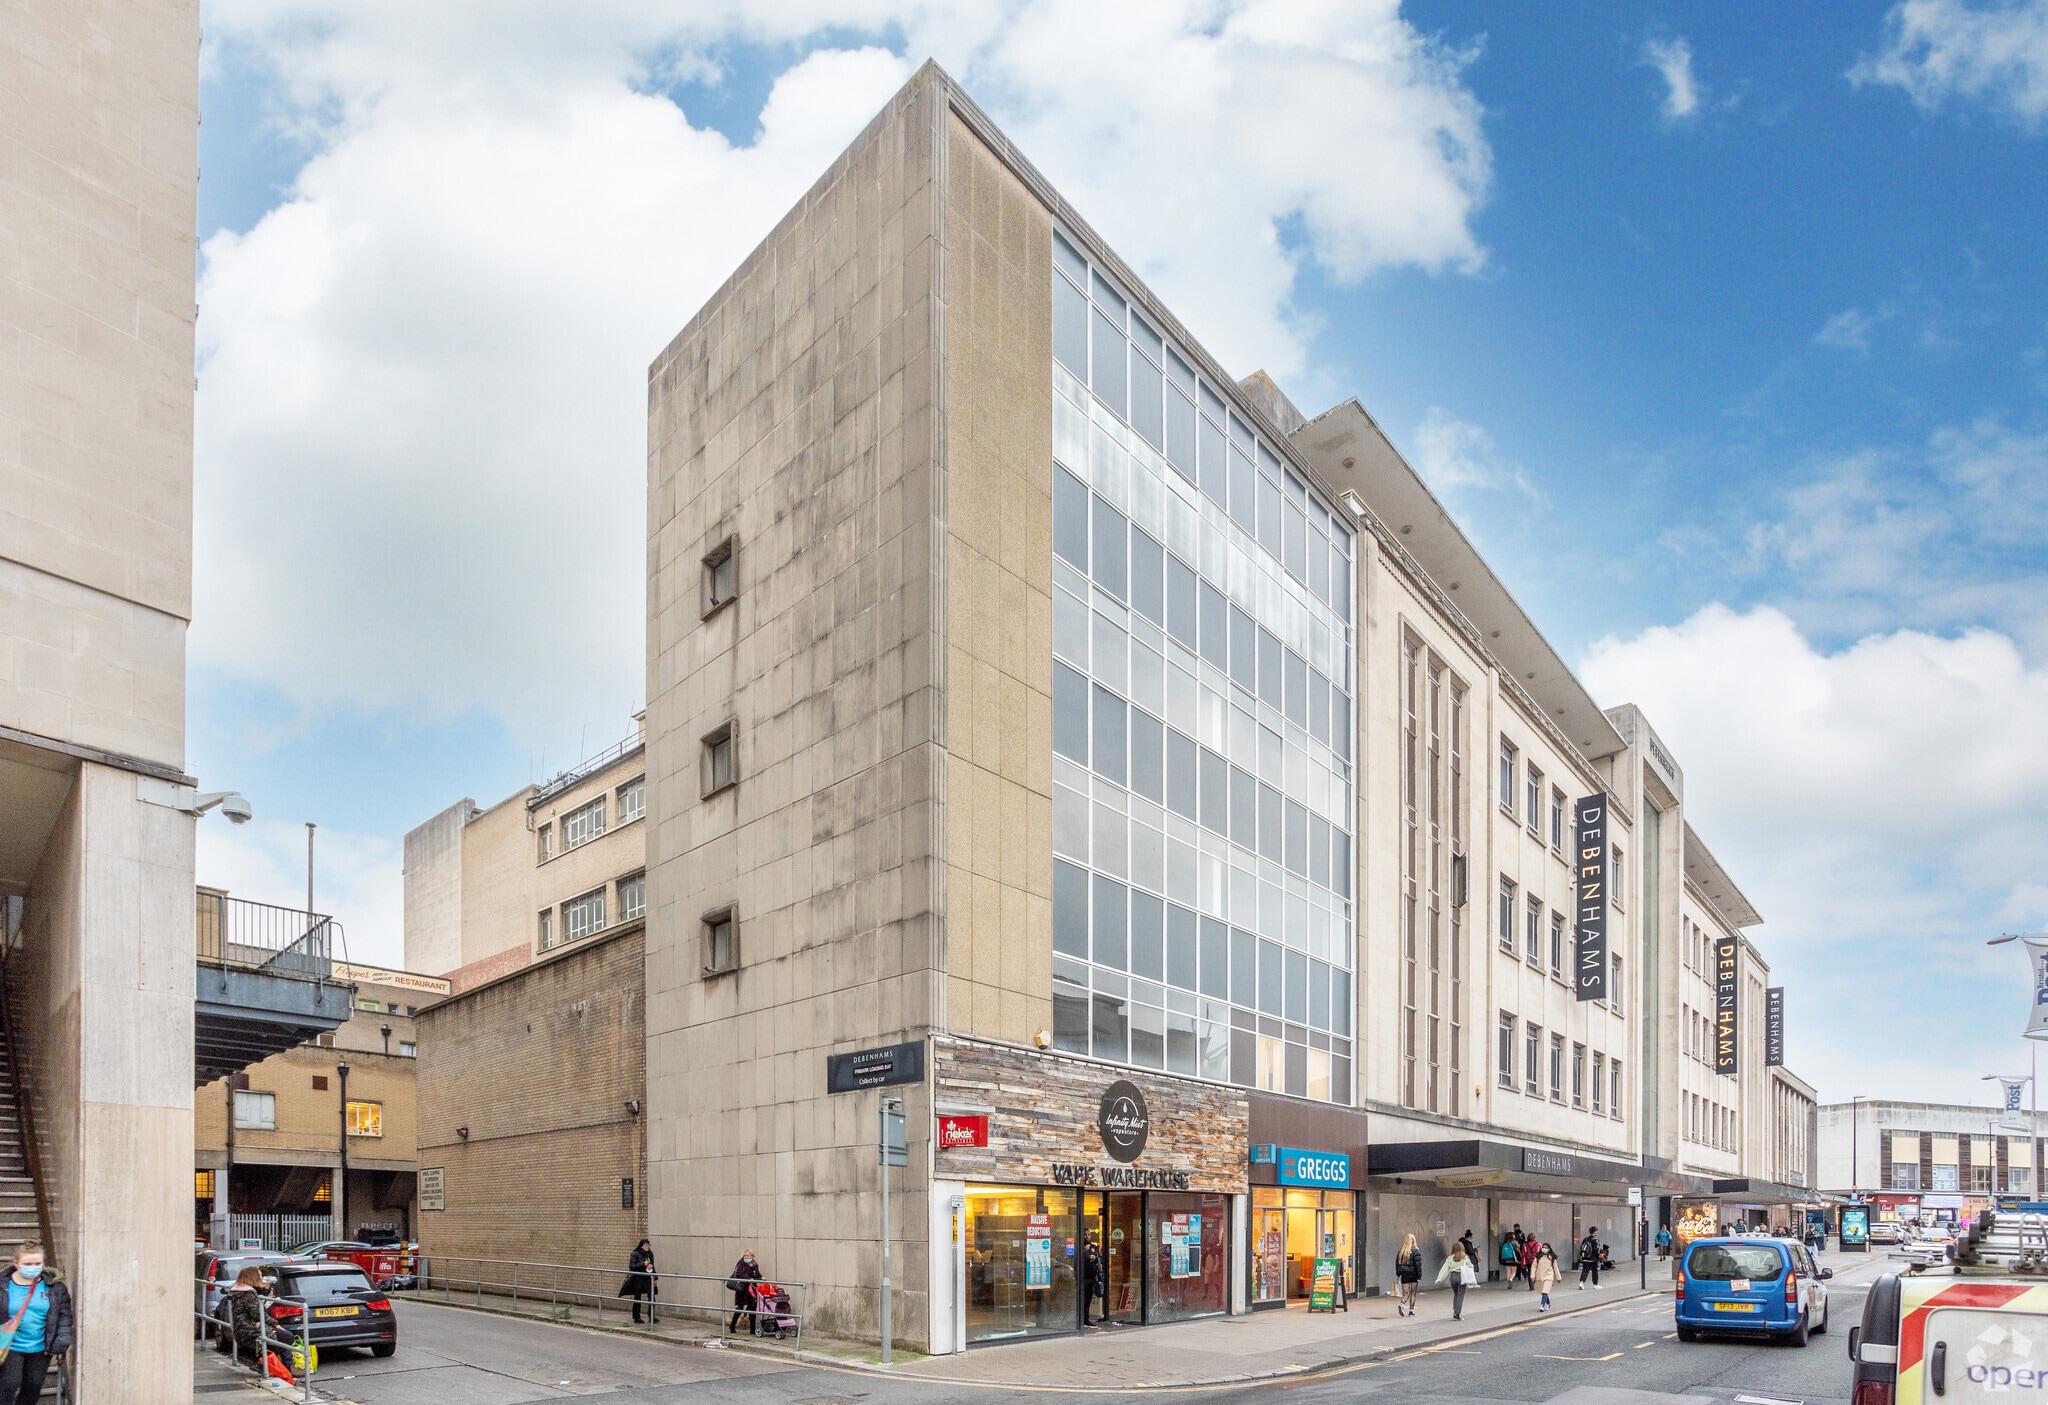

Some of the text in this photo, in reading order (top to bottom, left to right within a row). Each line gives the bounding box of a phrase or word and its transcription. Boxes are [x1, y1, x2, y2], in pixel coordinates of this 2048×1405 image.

[1582, 807, 1600, 988] DEBENHAMS
[394, 976, 447, 991] RESTAURANT
[1719, 944, 1734, 1066] DEBENHAMS
[1770, 992, 1779, 1062] DEBENHAMS
[853, 1050, 893, 1064] DEBENHAMS
[858, 1077, 873, 1085] Collect
[872, 1076, 878, 1085] by
[2006, 1084, 2021, 1112] Post
[1105, 1114, 1130, 1130] Infinity
[1297, 1157, 1347, 1182] GREGGS
[1527, 1153, 1571, 1172] DEBENHAMS
[1053, 1164, 1190, 1190] VAPE WAREHOUSE
